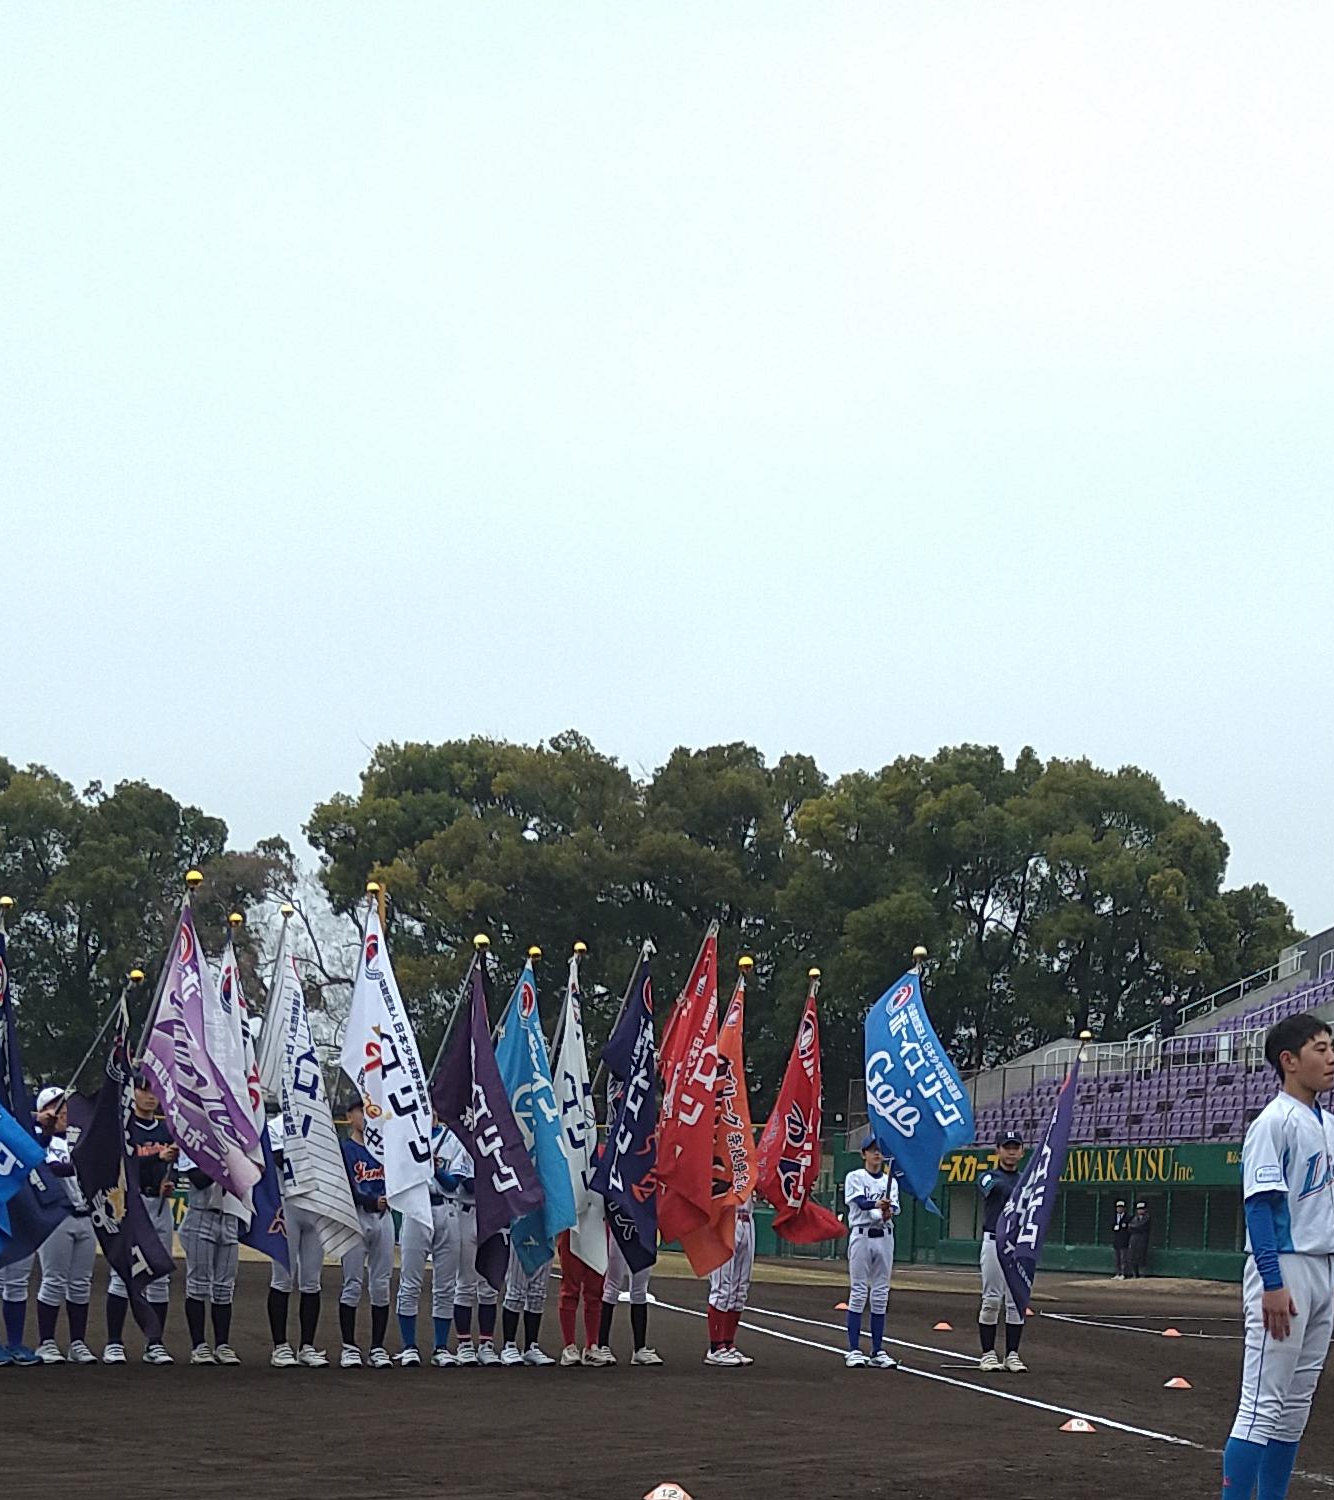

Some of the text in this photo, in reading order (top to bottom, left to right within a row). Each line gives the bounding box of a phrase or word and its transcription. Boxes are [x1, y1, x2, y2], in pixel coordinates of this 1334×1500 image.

[866, 1050, 921, 1138] Gojo
[922, 1041, 964, 1101] 日本少年野球連盟
[1060, 1147, 1194, 1183] AWAKATSU Inc.
